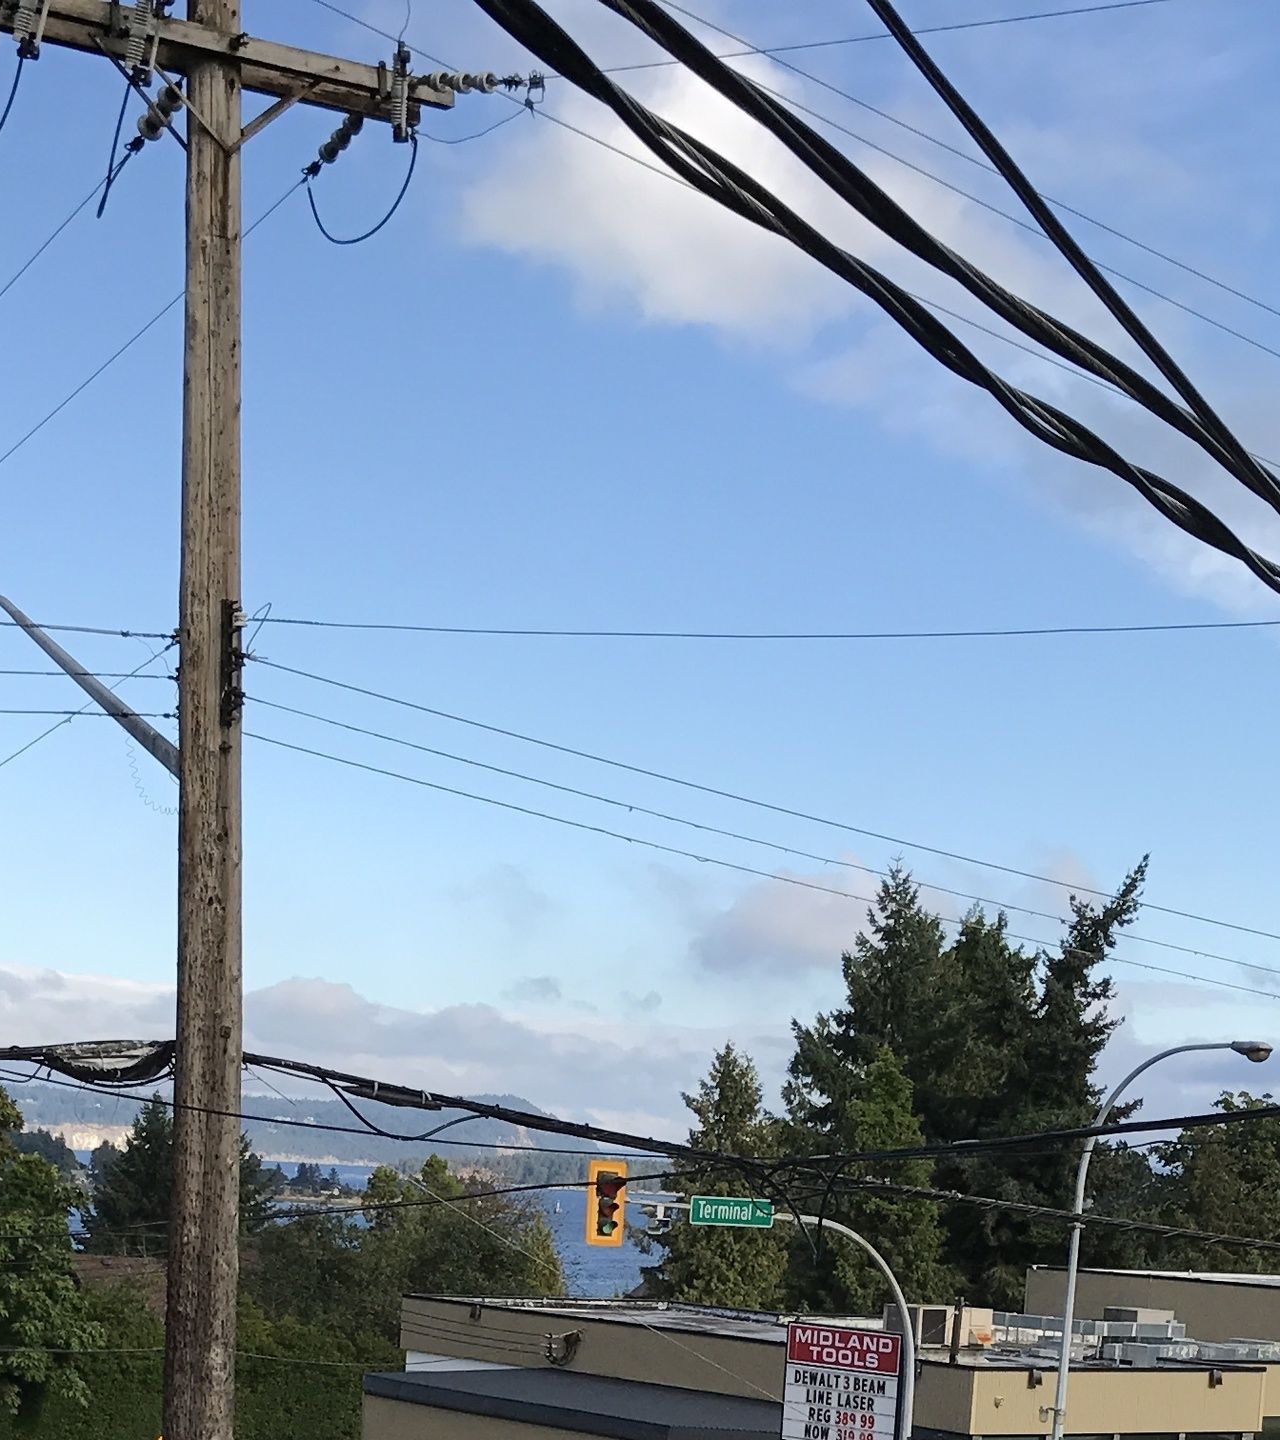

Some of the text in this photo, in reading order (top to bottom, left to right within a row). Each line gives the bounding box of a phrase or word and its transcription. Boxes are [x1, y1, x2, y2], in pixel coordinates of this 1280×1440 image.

[698, 1200, 753, 1221] Terminal
[795, 1328, 893, 1353] MIDLAND
[809, 1346, 879, 1368] TOOLS
[794, 1369, 886, 1395] DEWALT 3 BEAM
[806, 1388, 875, 1412] LINE LASER
[808, 1407, 875, 1430] REG 389 99
[804, 1424, 830, 1440] NOW
